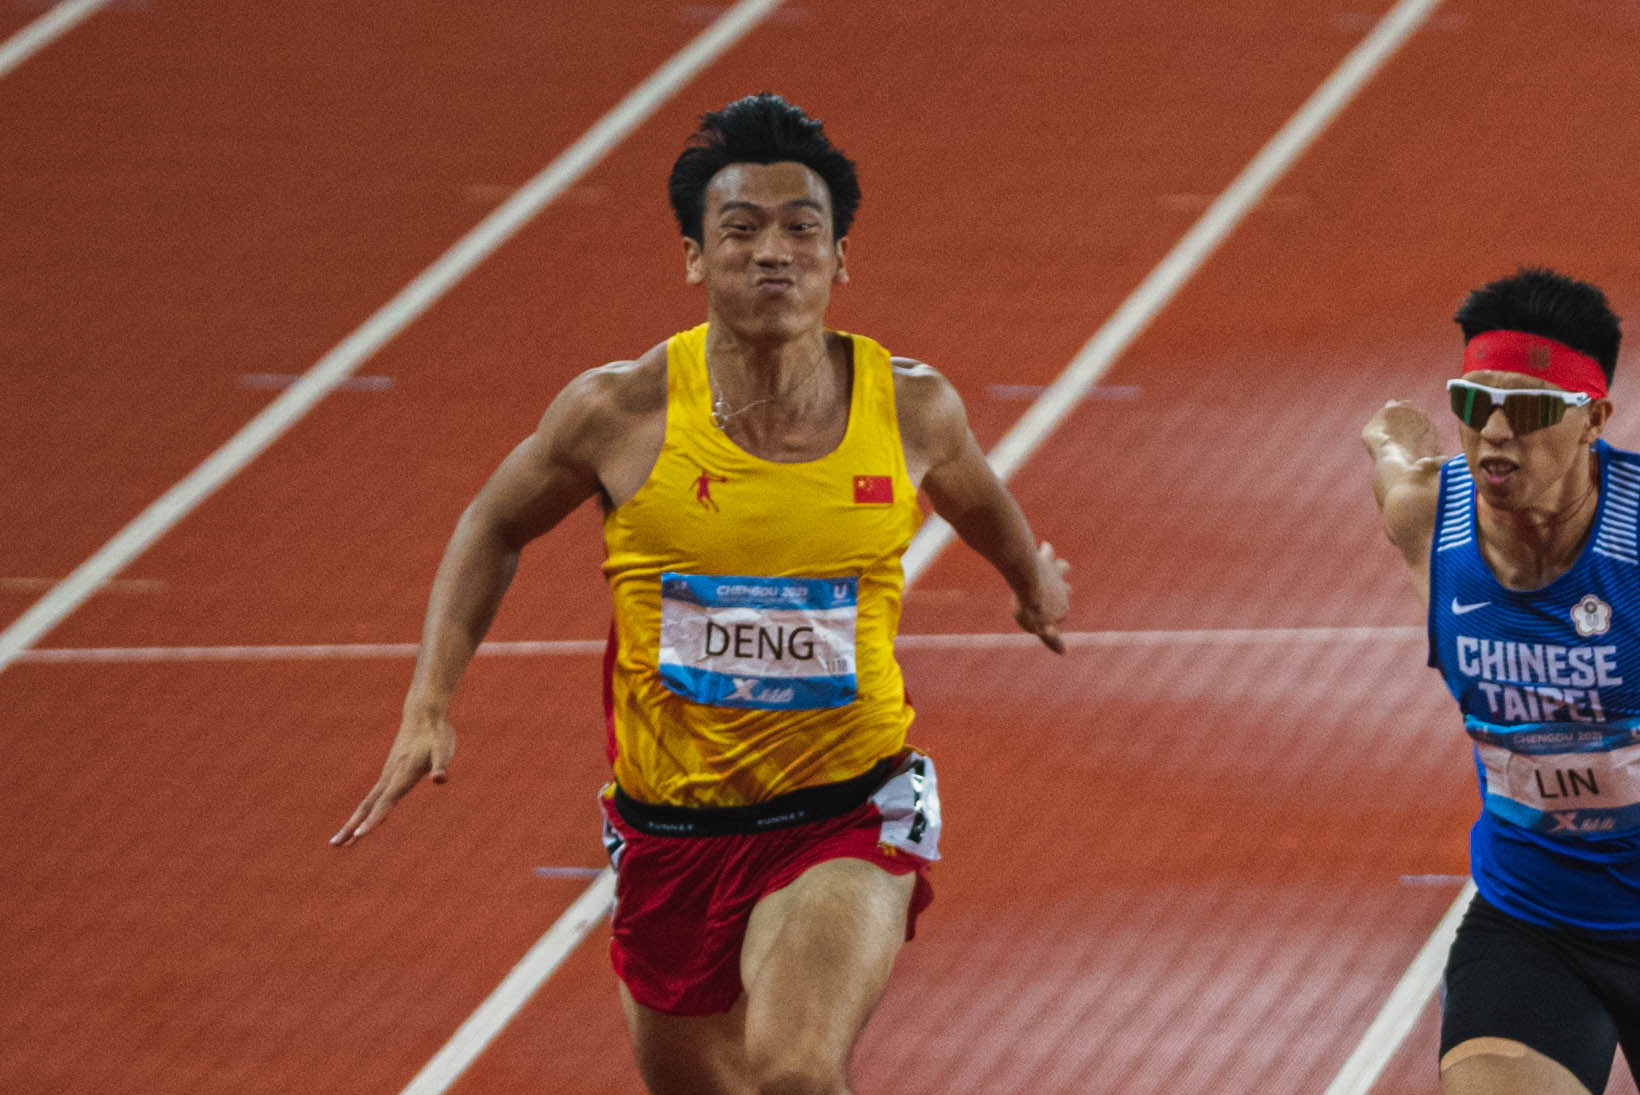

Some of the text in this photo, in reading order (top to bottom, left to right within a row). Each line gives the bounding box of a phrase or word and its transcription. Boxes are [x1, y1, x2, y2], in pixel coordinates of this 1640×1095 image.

[705, 619, 814, 661] DENG
[1456, 635, 1623, 688] CHINESE
[1478, 682, 1606, 722] TAIPEI
[1534, 767, 1601, 800] LIN
